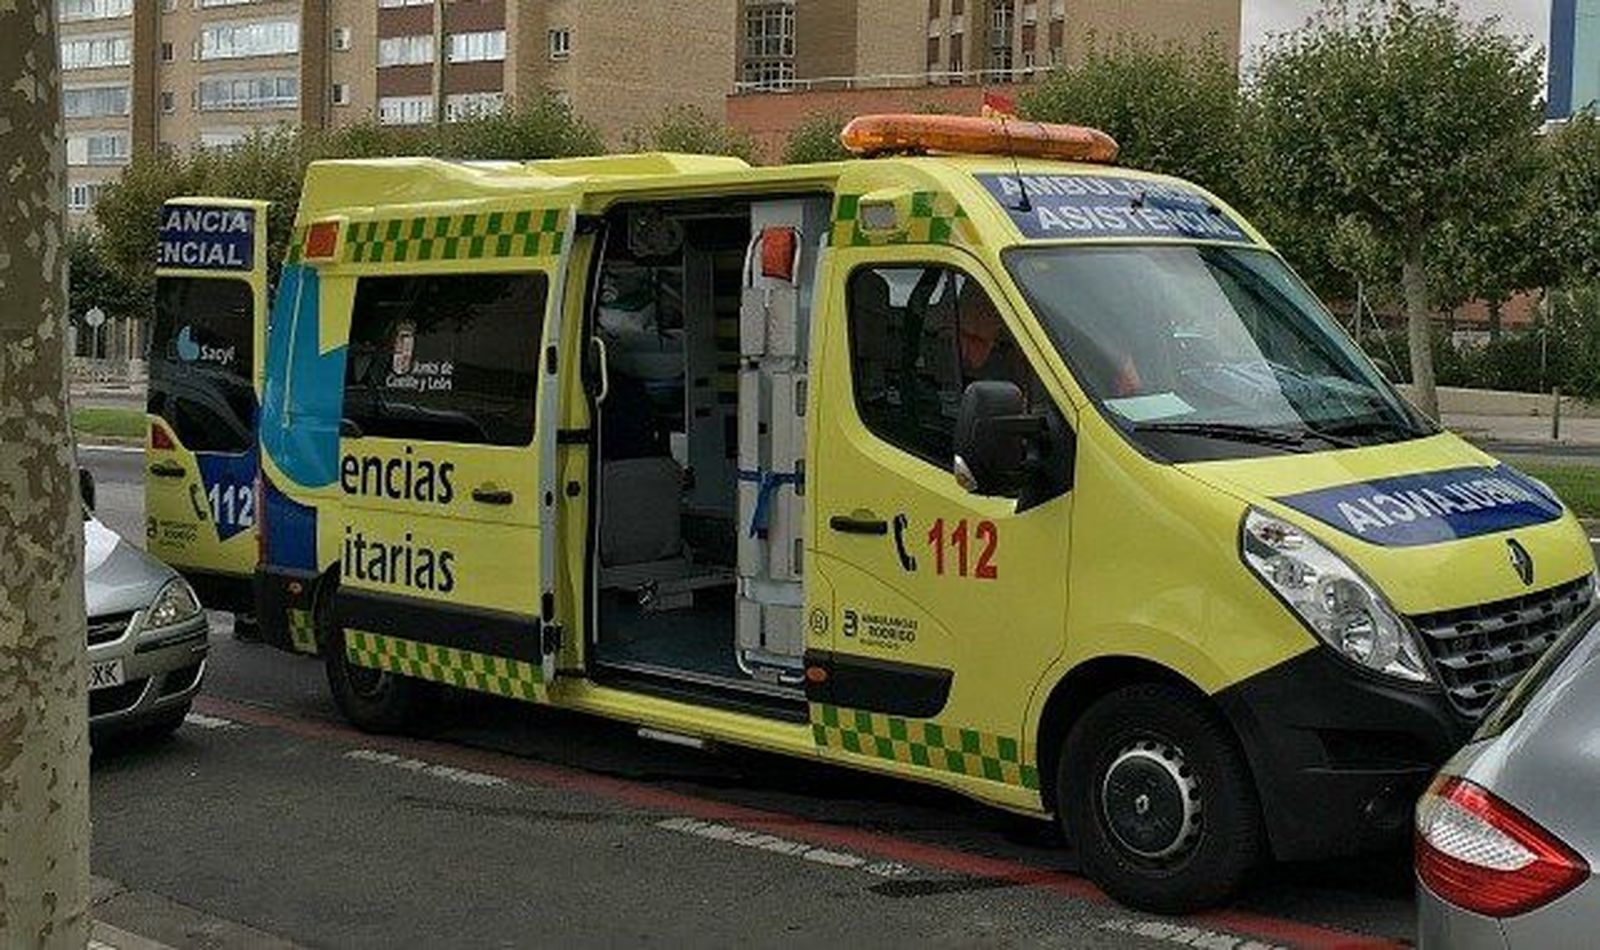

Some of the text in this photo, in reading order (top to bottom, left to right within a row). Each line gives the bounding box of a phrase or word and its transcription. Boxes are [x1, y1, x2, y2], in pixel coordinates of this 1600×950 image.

[341, 446, 455, 504] encias
[209, 483, 253, 527] 112
[344, 526, 455, 592] itarias
[928, 518, 998, 579] 112
